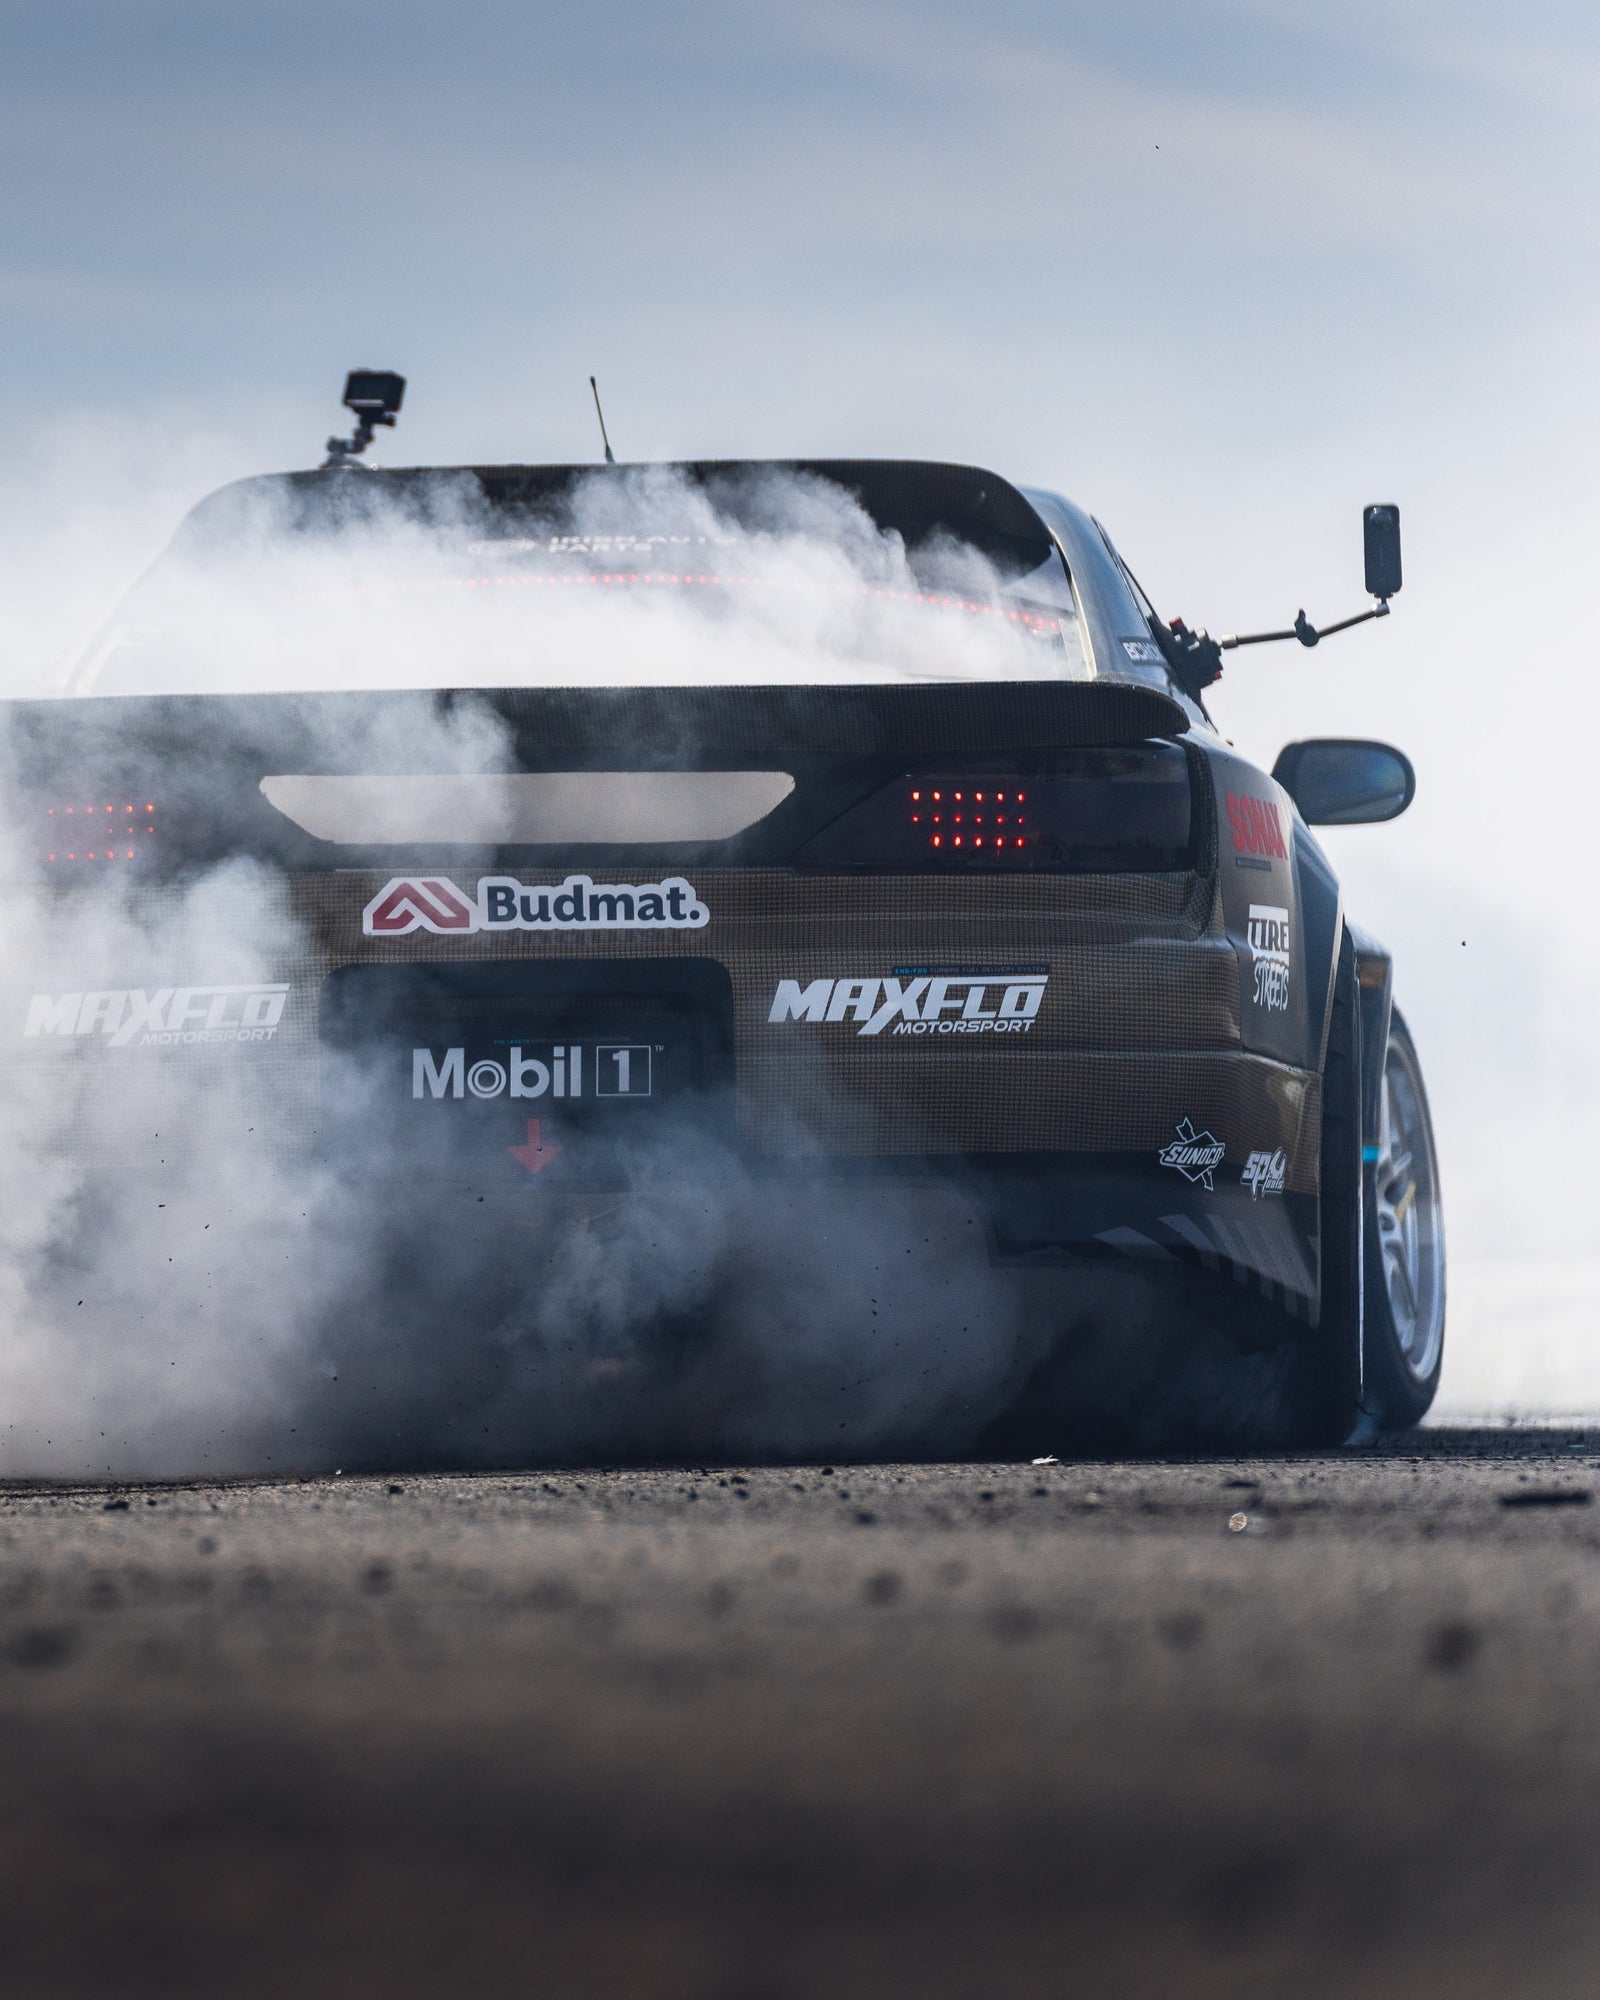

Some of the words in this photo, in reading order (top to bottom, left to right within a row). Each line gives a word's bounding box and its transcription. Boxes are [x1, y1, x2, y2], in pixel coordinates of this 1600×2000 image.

[549, 543, 653, 552] PARTS
[551, 536, 636, 544] IRISH
[1226, 792, 1289, 860] SONAX
[486, 883, 701, 923] Budmat.
[1248, 917, 1290, 952] TIRE
[23, 982, 291, 1047] MAXFLO
[767, 975, 1049, 1035] MAXFLO
[140, 1027, 278, 1046] MOTORSPORT
[892, 1019, 1036, 1035] MOTORSPORT
[412, 1046, 582, 1099] Mobil
[1164, 1145, 1223, 1165] SUNOCO
